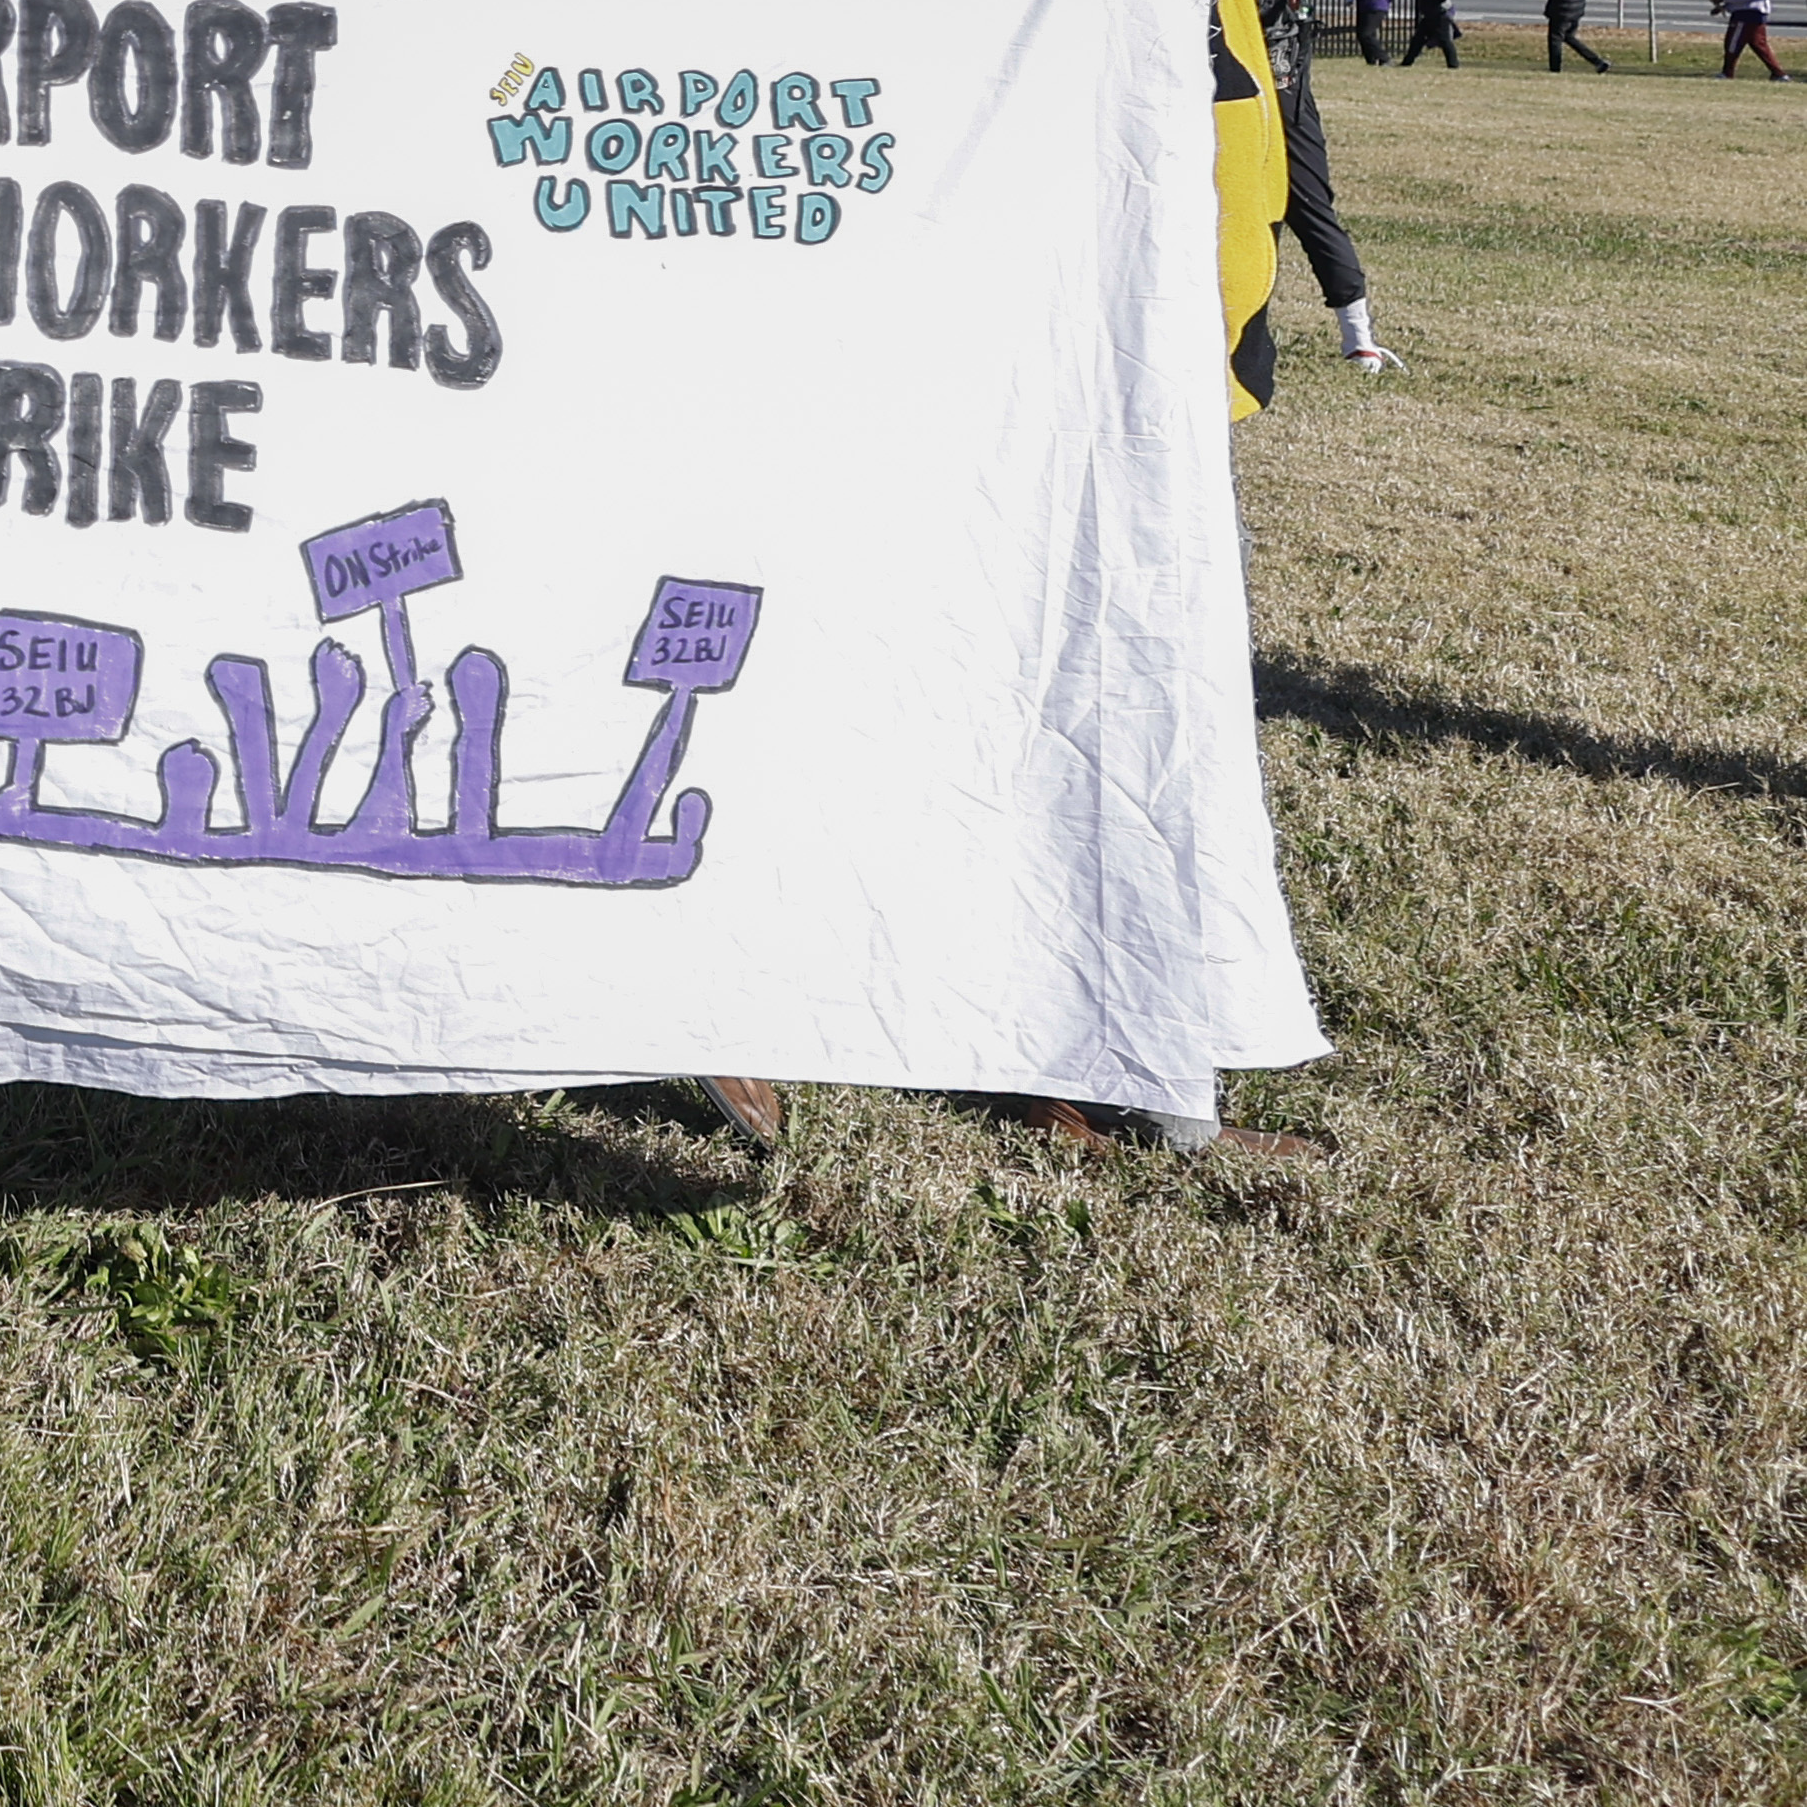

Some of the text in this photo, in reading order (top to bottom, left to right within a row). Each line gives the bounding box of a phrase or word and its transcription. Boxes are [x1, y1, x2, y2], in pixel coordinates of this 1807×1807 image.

[524, 66, 881, 132] AIRPORT
[487, 112, 895, 194] WORKERS
[534, 175, 842, 245] UNITED
[325, 536, 442, 598] ON Strike
[657, 596, 735, 630] SEIU
[651, 634, 727, 666] 32BJ
[0, 684, 95, 718] 32BJ
